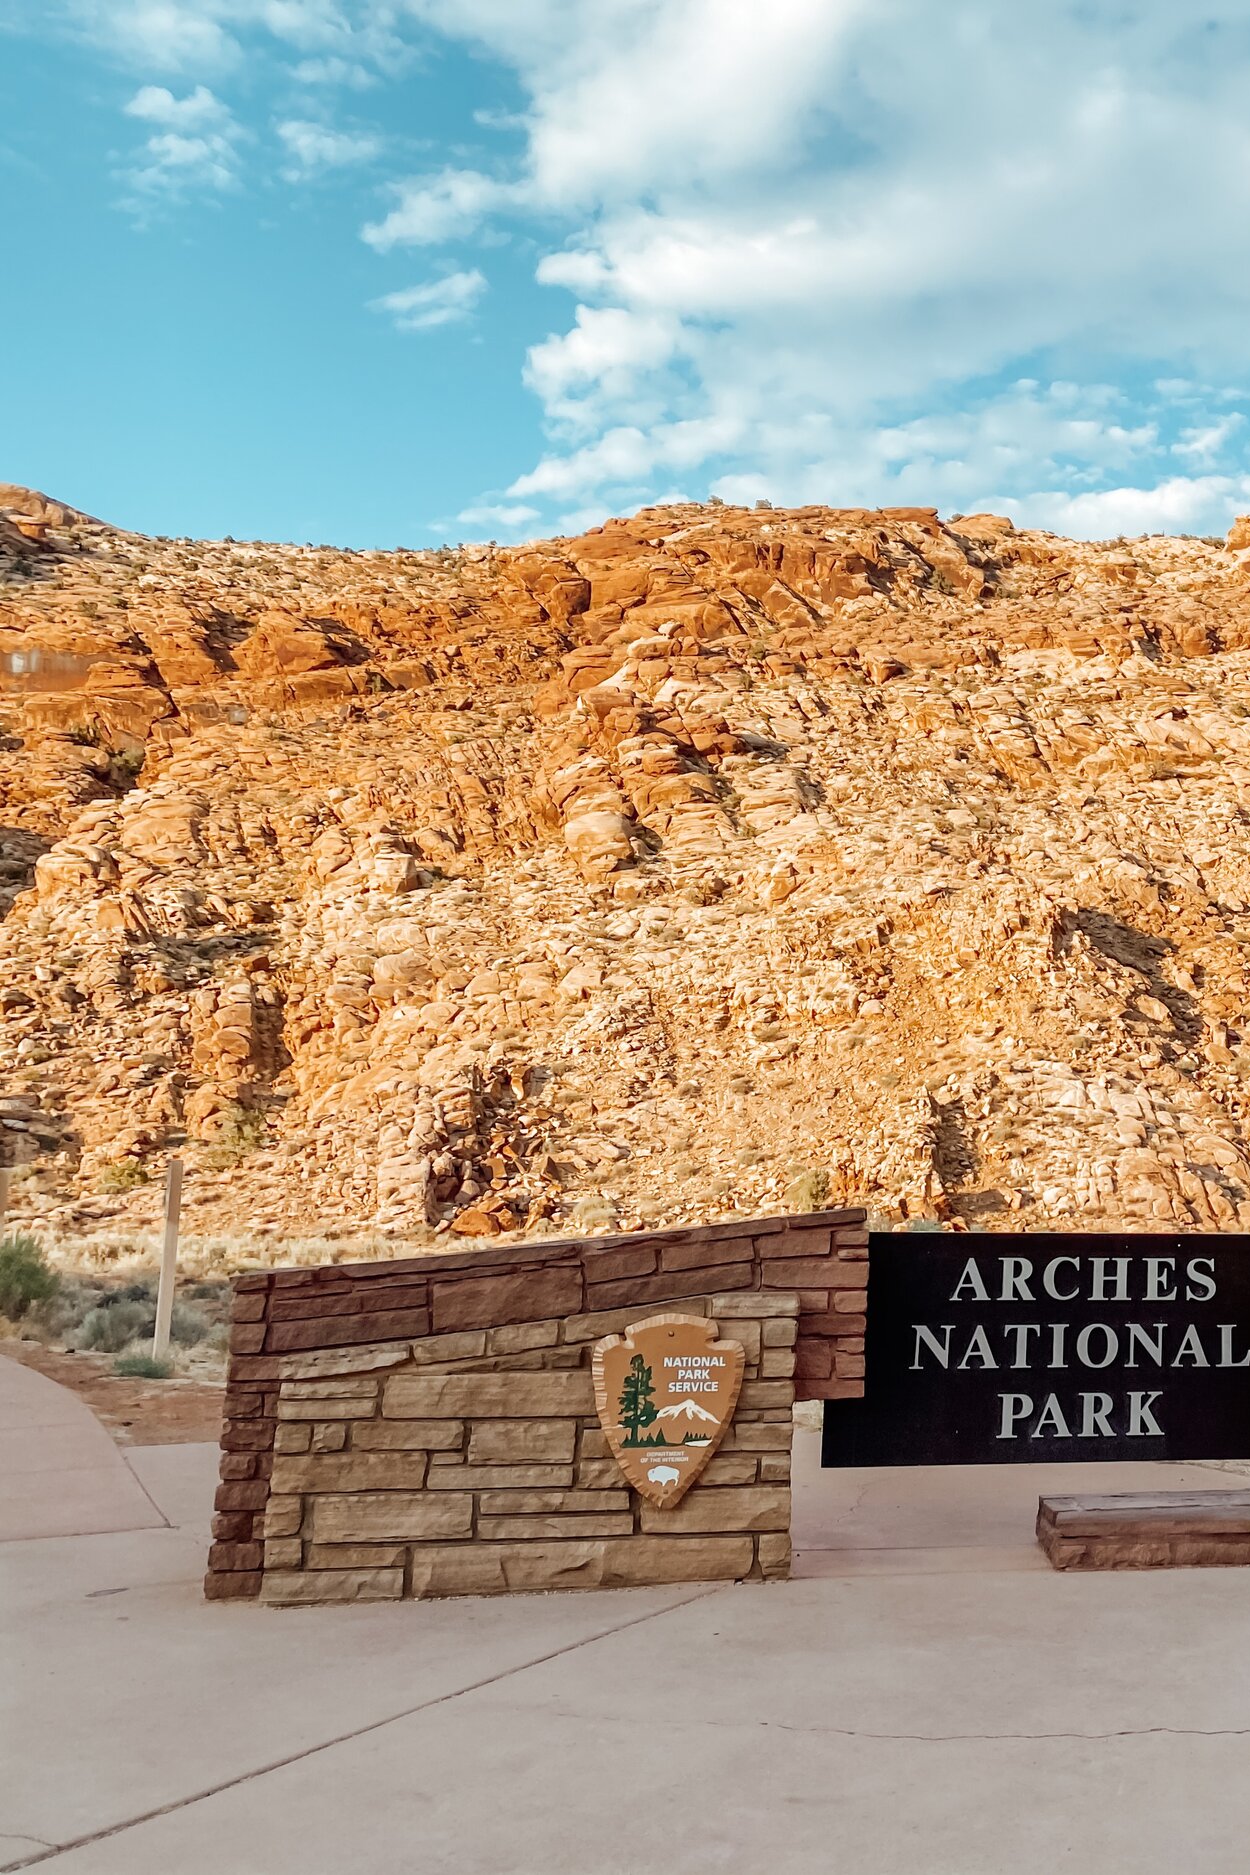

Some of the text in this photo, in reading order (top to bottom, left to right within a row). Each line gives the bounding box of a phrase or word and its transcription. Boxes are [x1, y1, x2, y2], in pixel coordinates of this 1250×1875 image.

[949, 1256, 1218, 1302] ARCHES
[663, 1356, 726, 1367] NATIONAL
[677, 1369, 710, 1380] PARK
[668, 1381, 719, 1393] SERVICE
[996, 1391, 1165, 1439] PARK
